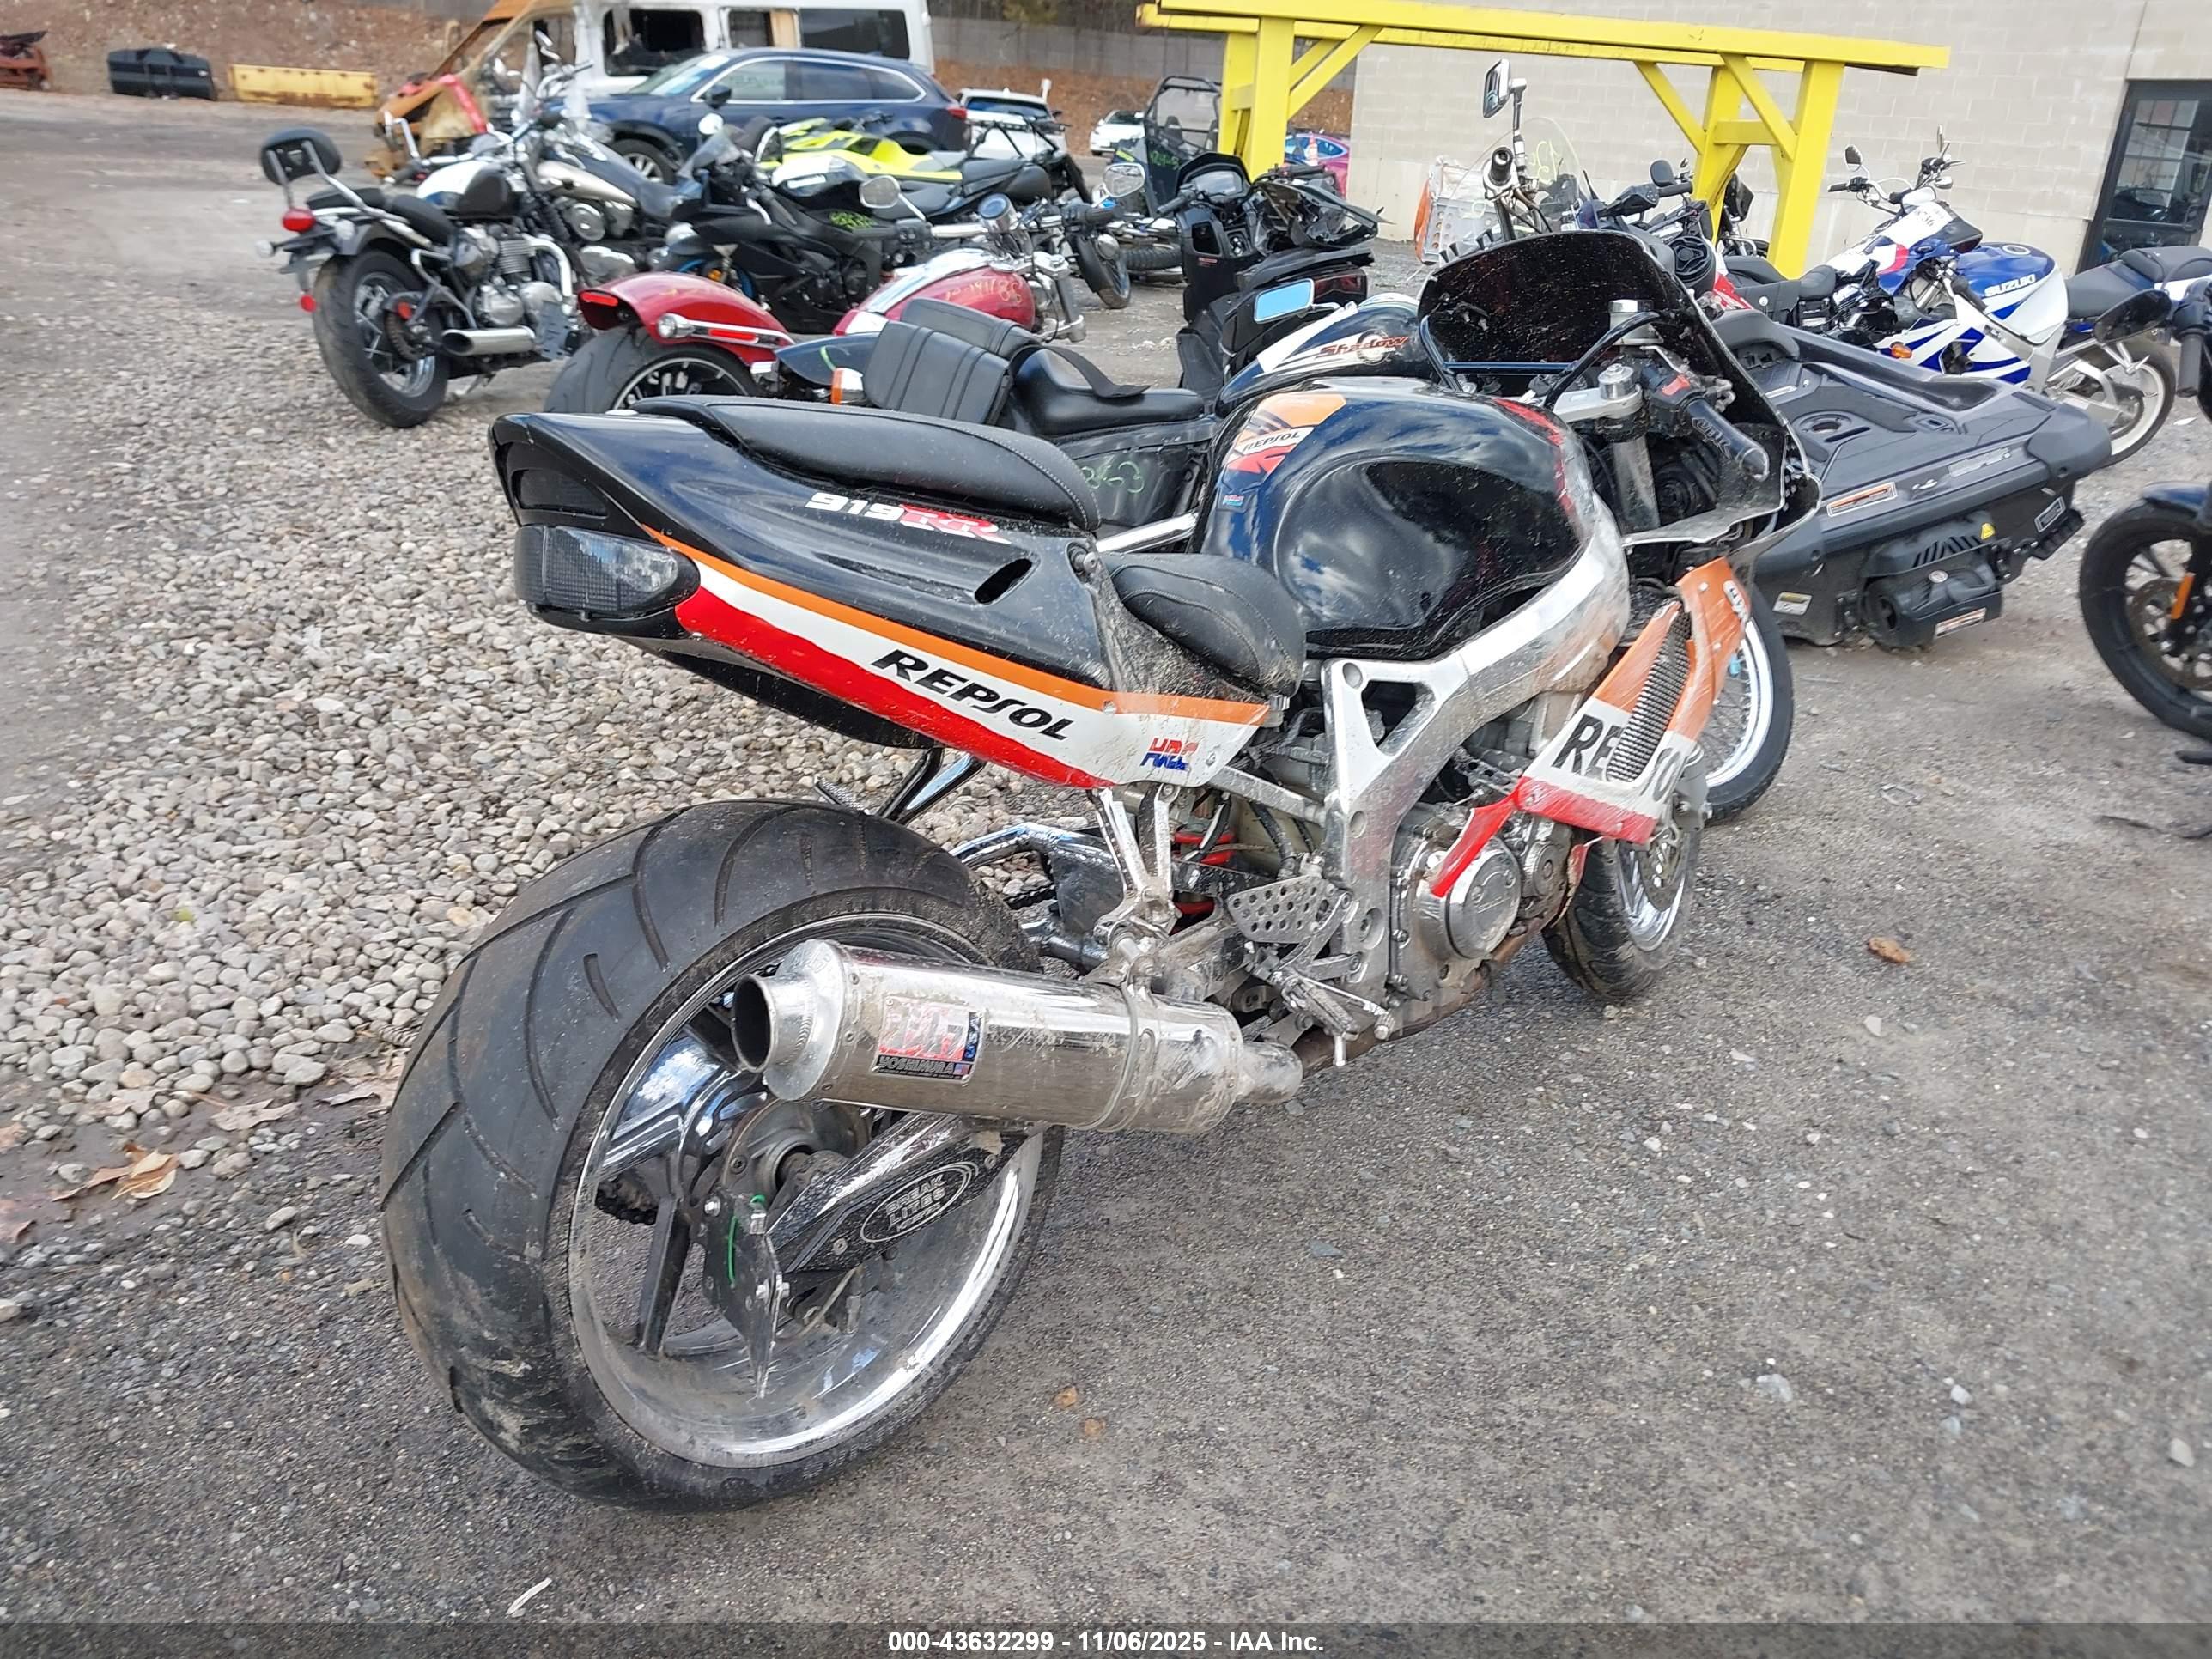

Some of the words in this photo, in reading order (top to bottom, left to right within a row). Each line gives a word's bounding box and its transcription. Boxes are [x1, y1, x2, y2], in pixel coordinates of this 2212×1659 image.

[1984, 274, 2036, 297] SUZUKI
[1315, 336, 1409, 359] Shadow
[1242, 432, 1301, 453] REPSOL
[871, 649, 1074, 741] REPSOL
[878, 1055, 955, 1073] YOSHIMURA
